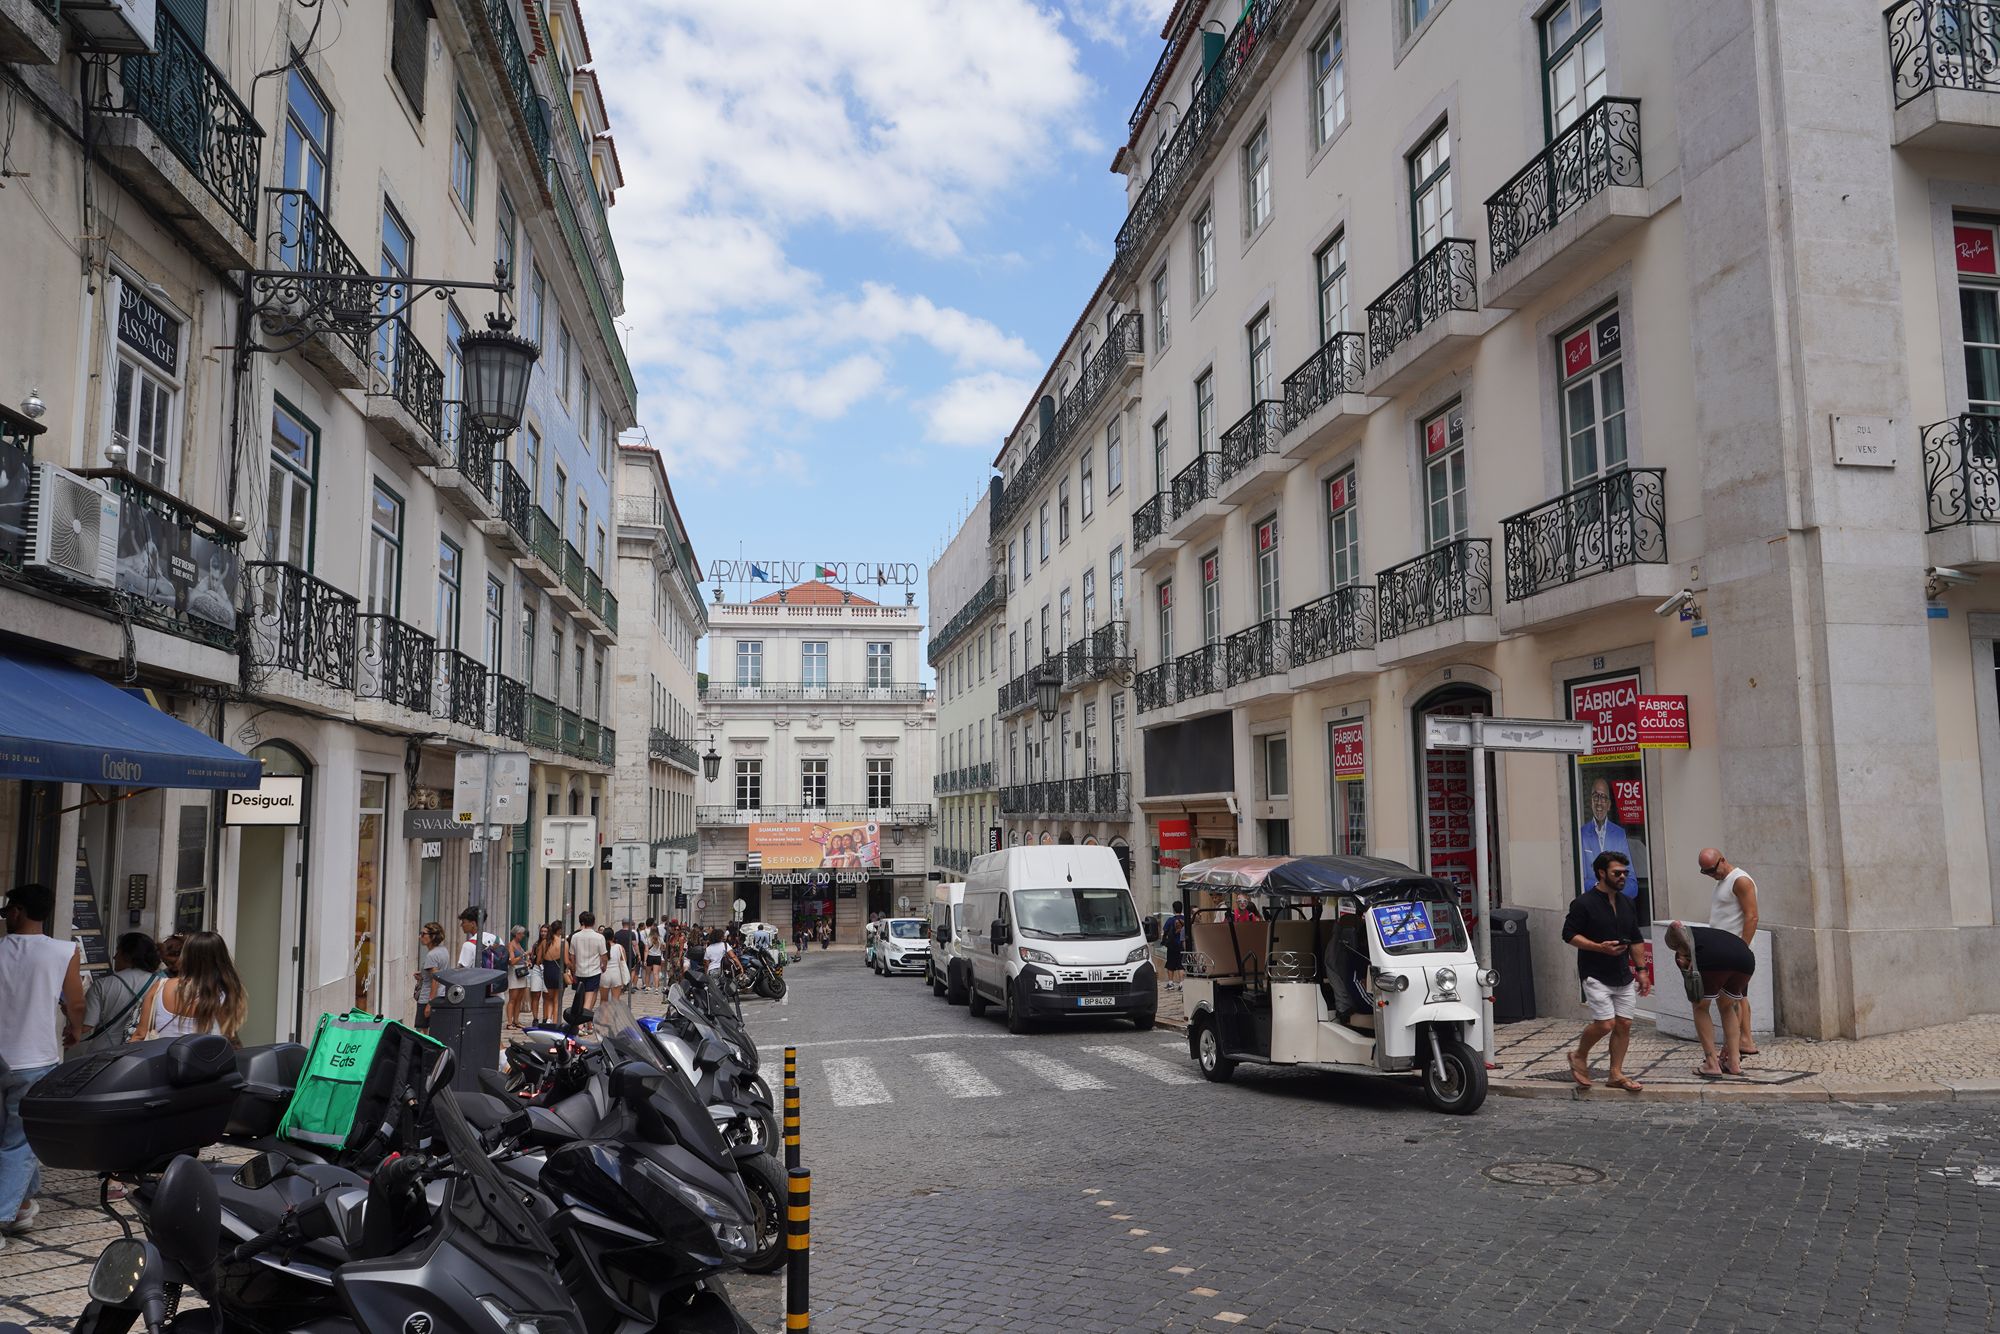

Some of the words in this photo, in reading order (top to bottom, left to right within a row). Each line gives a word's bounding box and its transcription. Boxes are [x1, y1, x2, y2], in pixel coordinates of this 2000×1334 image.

[120, 284, 166, 335] SPORT
[118, 312, 175, 367] ASSAGE
[1856, 425, 1871, 434] RUA
[1856, 445, 1878, 454] IVENS
[825, 562, 848, 584] DO
[1576, 687, 1636, 713] FÁBRICA
[1639, 698, 1685, 710] FÁBRICA
[1599, 710, 1613, 724] DE
[1640, 716, 1685, 728] ÓCULOS
[1334, 729, 1363, 744] FÁBRICA
[1592, 722, 1637, 745] CULOS
[1345, 744, 1352, 753] DE
[1335, 752, 1363, 767] ÓCULOS
[102, 753, 142, 781] Castro
[1616, 782, 1640, 799] 79€
[231, 793, 295, 809] Desigual.
[767, 855, 815, 864] SEPHORA
[761, 872, 811, 885] ARMAZENS
[817, 872, 830, 884] DO
[836, 872, 869, 884] CHIADO
[1088, 968, 1103, 981] FIAT
[336, 1041, 362, 1054] Uber
[329, 1054, 356, 1068] Eats
